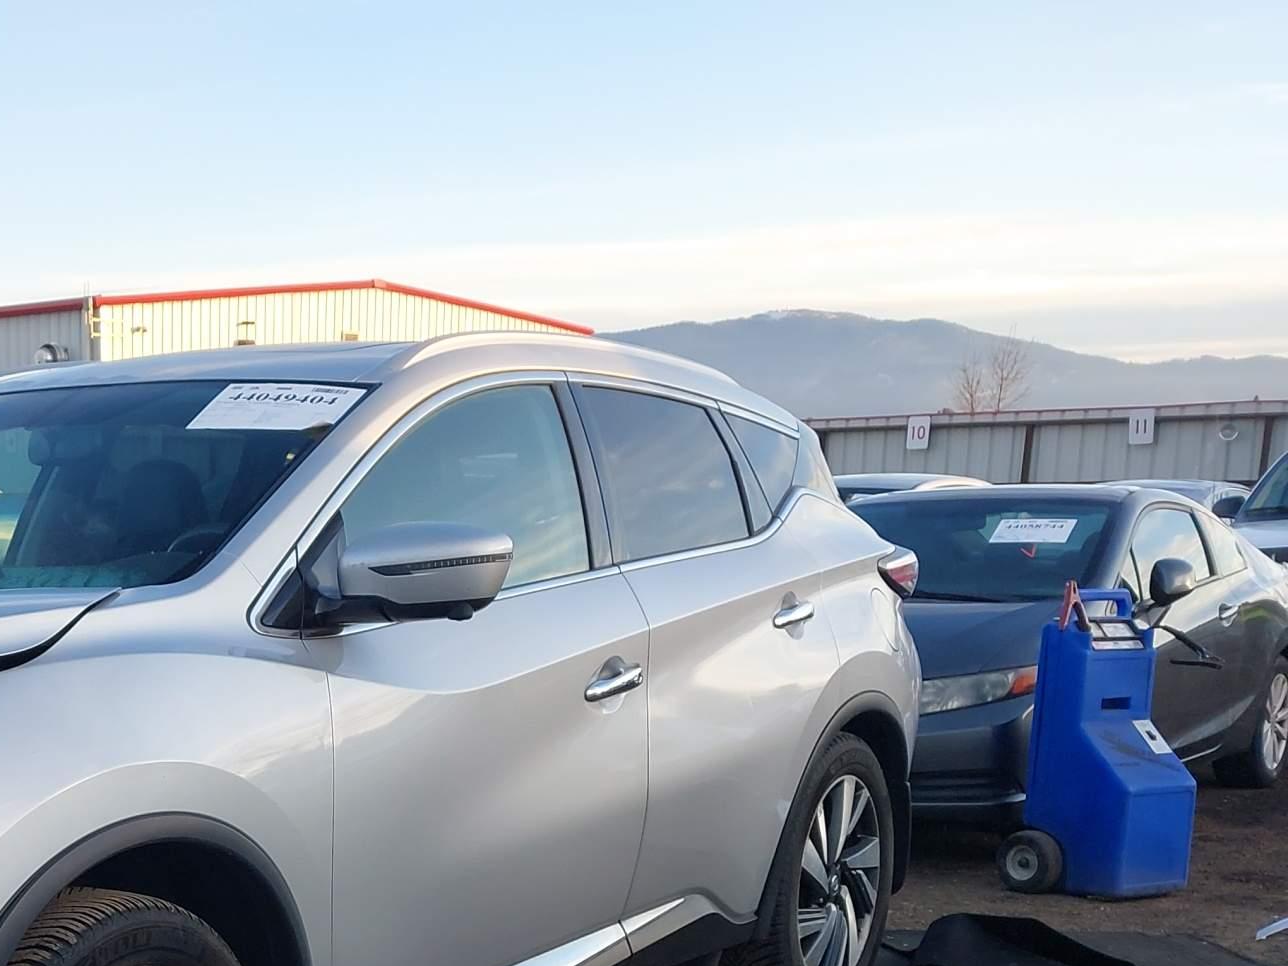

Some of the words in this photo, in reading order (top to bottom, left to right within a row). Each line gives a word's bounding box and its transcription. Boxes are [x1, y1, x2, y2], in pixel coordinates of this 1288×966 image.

[228, 392, 339, 405] 44049404
[911, 425, 926, 440] 10
[1135, 418, 1147, 434] 11
